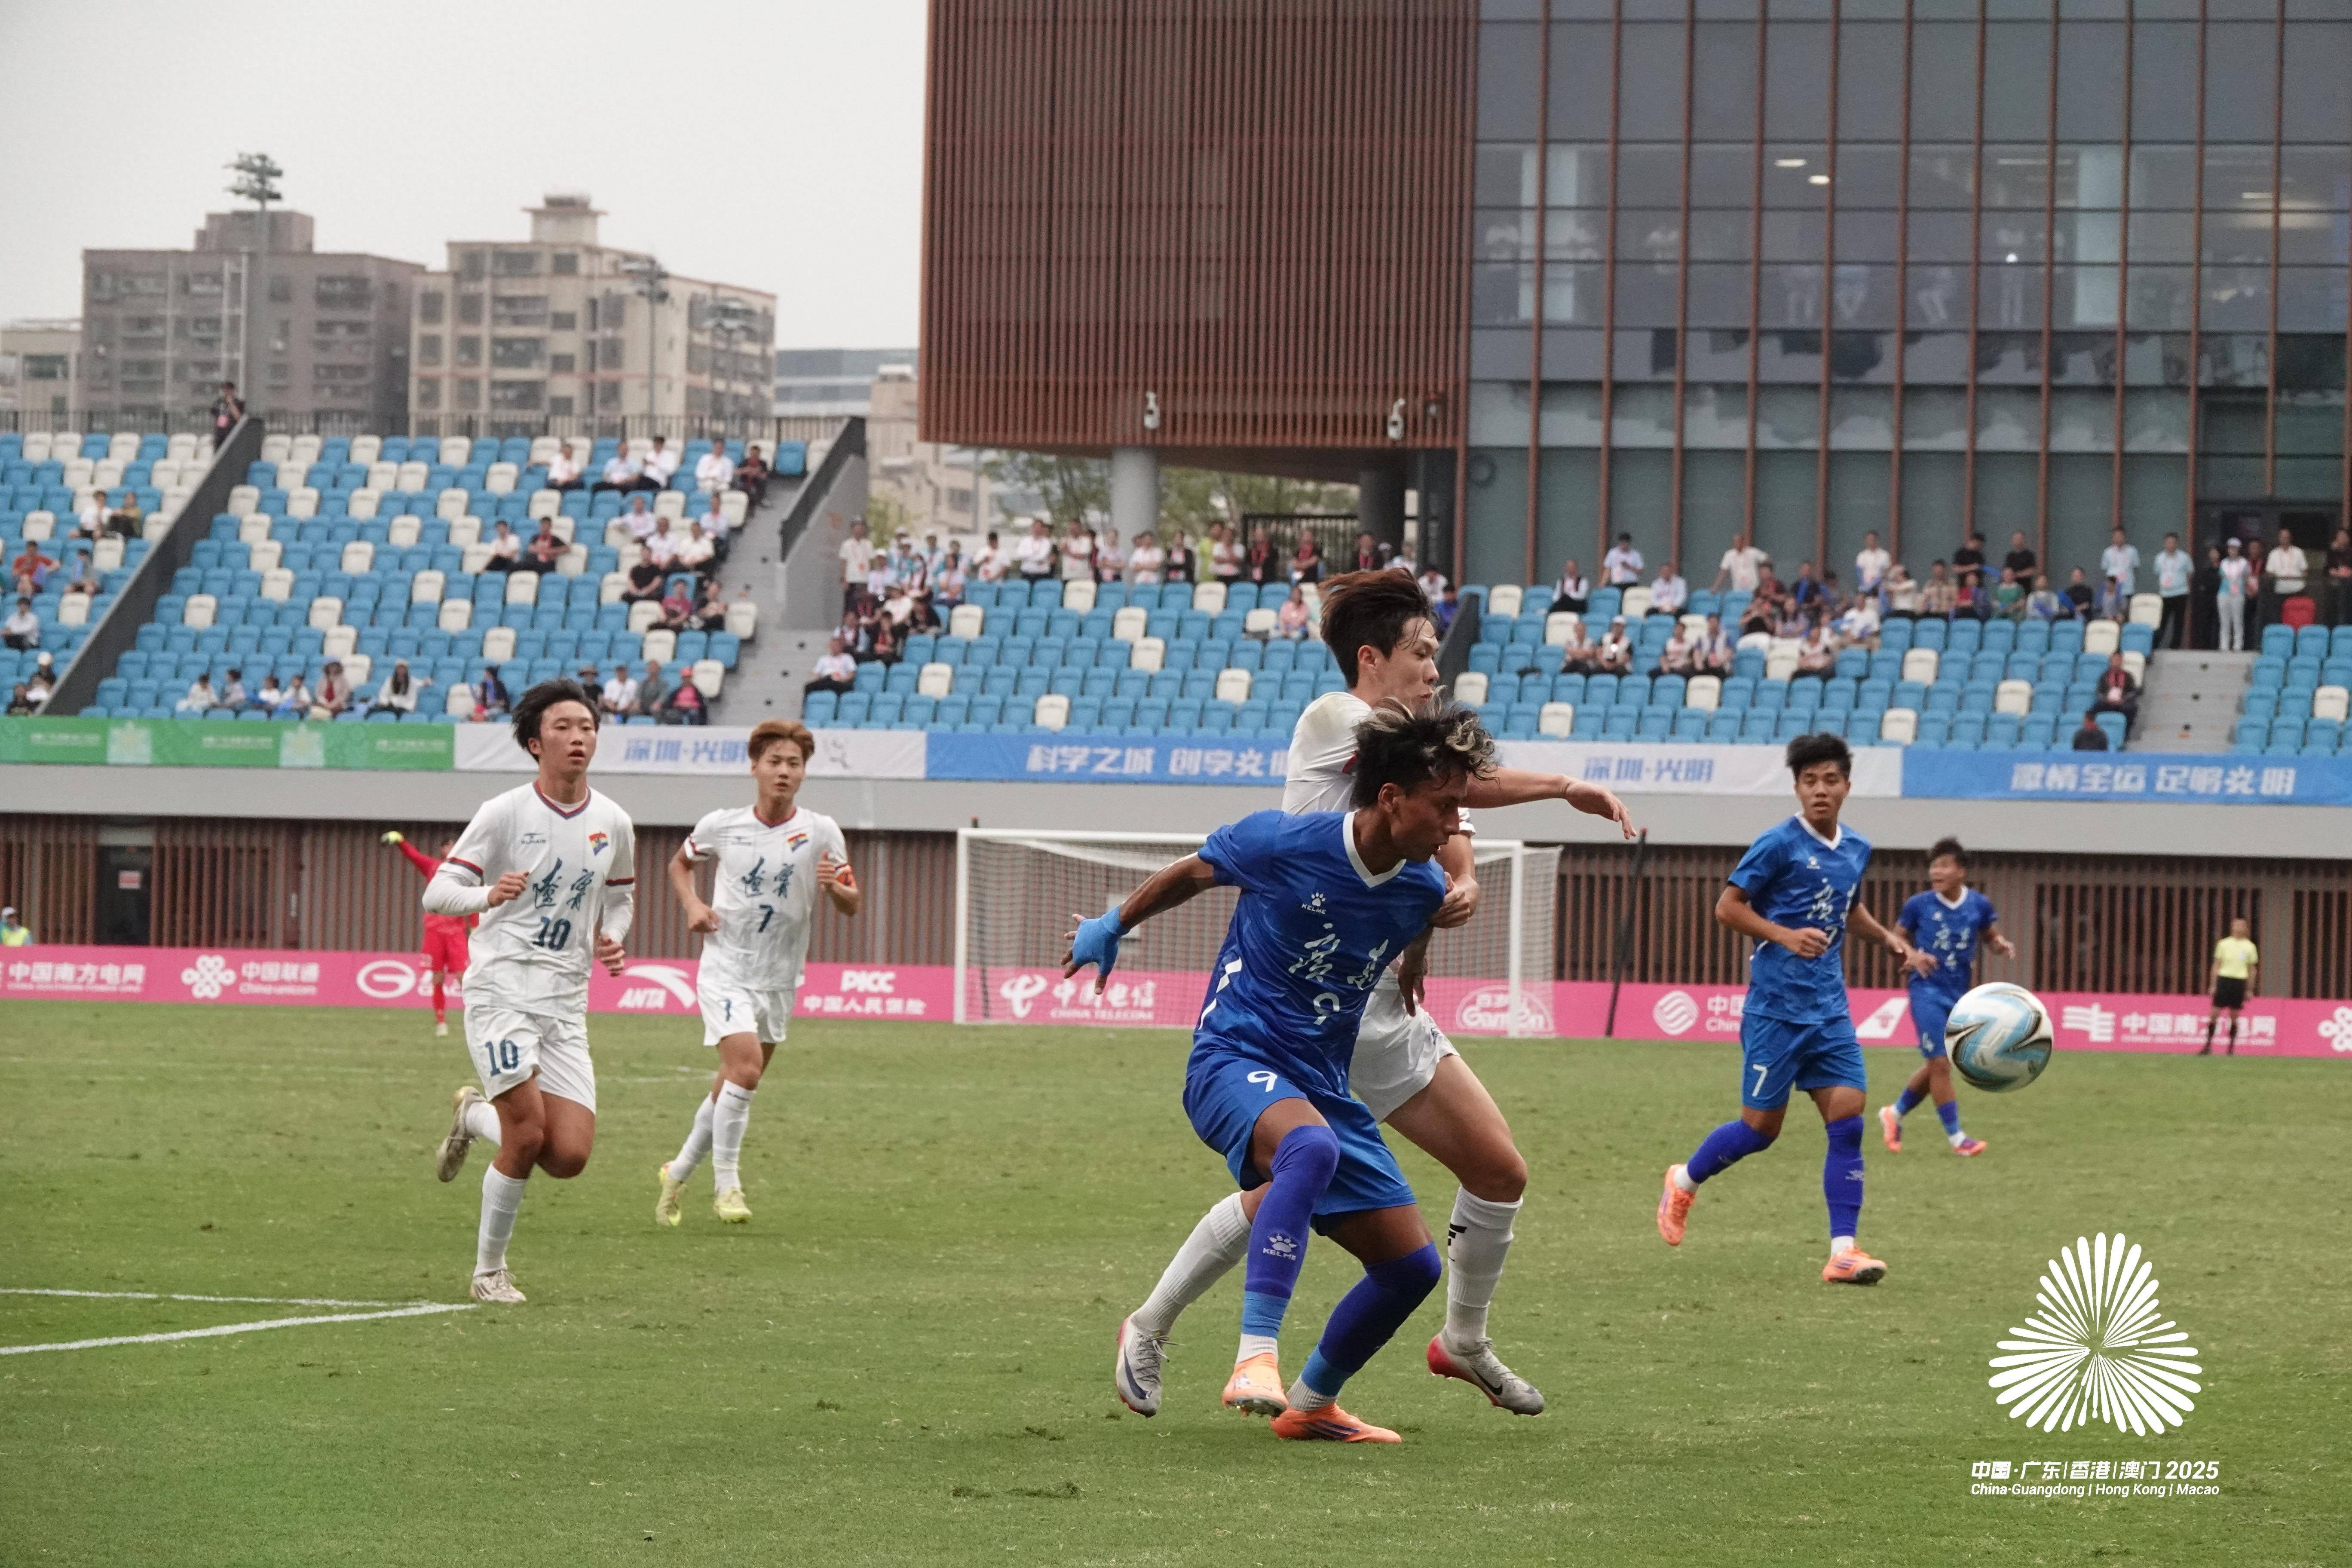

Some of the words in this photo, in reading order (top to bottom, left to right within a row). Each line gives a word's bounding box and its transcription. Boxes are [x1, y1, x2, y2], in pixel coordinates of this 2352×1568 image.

[1026, 744, 1155, 773] 科学之城
[757, 904, 775, 933] 7
[1301, 903, 1326, 914] KELME
[532, 916, 571, 951] 10
[8, 961, 147, 984] 中国南方电网
[840, 970, 896, 994] PICC
[616, 988, 667, 1009] ANTA
[802, 994, 926, 1015] 中国人民保险
[485, 1039, 519, 1077] 10
[1247, 1071, 1277, 1092] 9
[1752, 1063, 1768, 1097] 7
[1262, 1247, 1297, 1261] KELME
